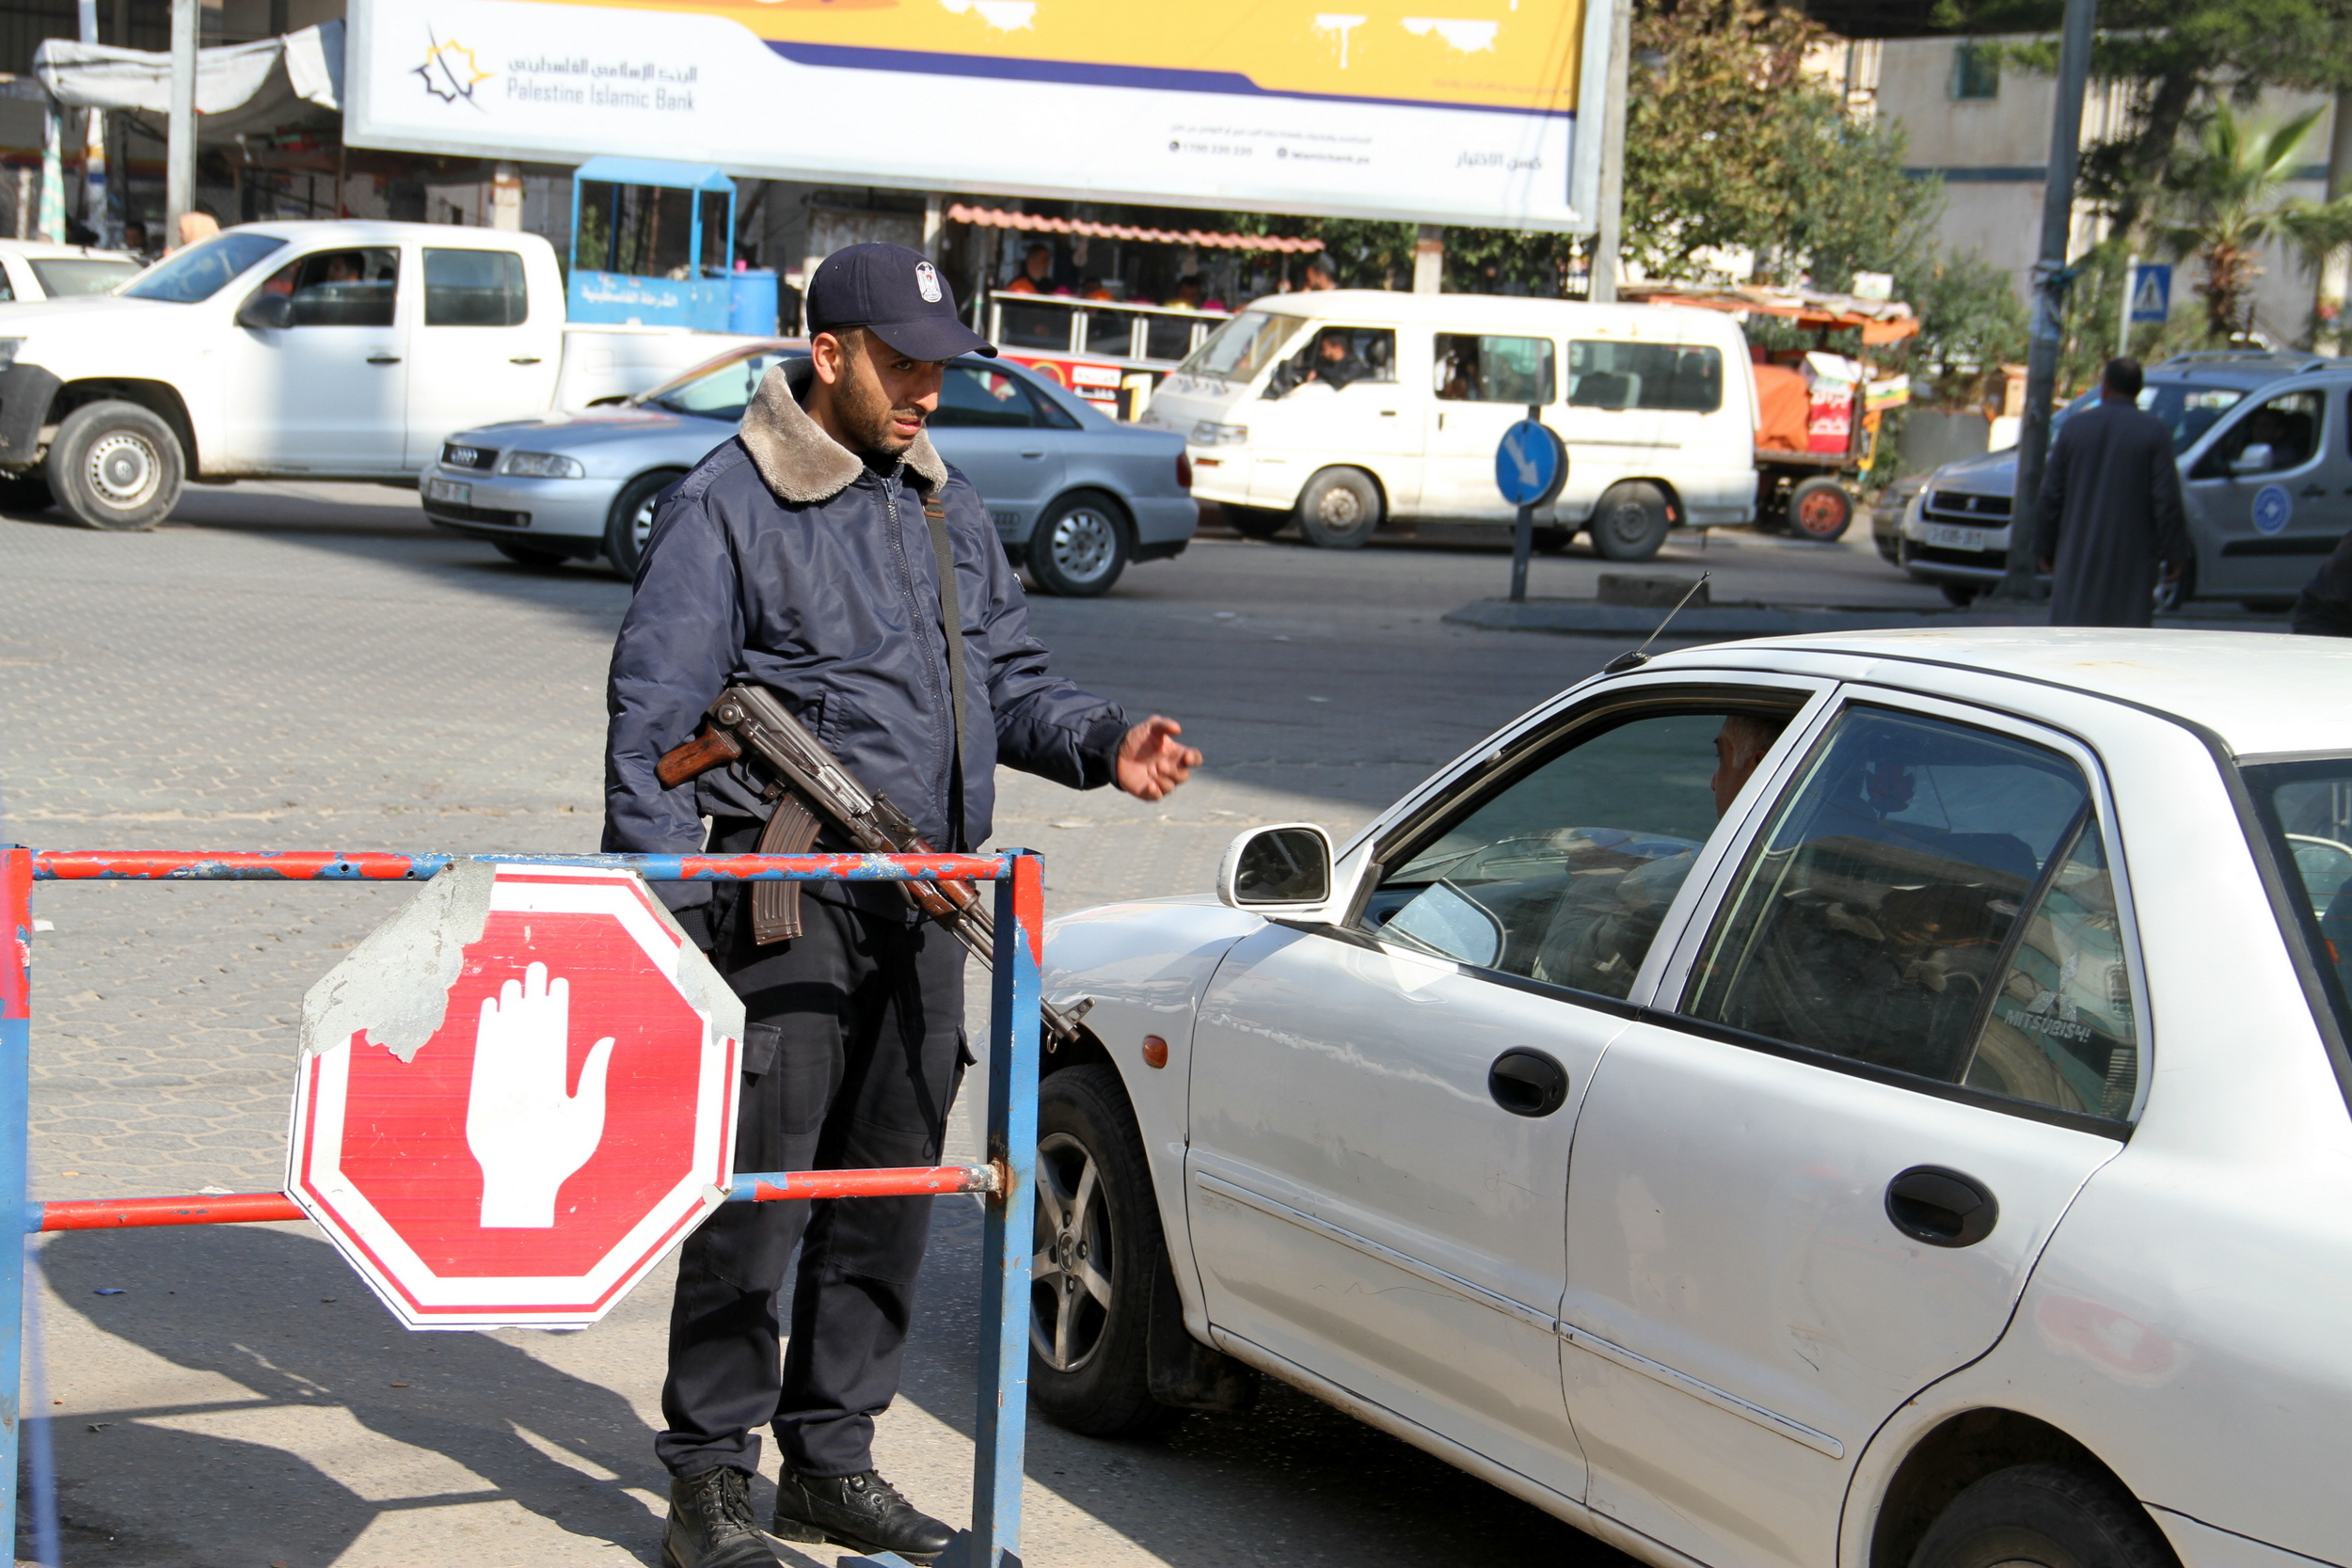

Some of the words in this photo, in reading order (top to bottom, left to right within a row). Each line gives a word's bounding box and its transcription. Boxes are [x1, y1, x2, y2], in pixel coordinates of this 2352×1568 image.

[507, 76, 583, 104] Palestine
[590, 83, 650, 109] Islamic
[656, 87, 695, 111] Bank
